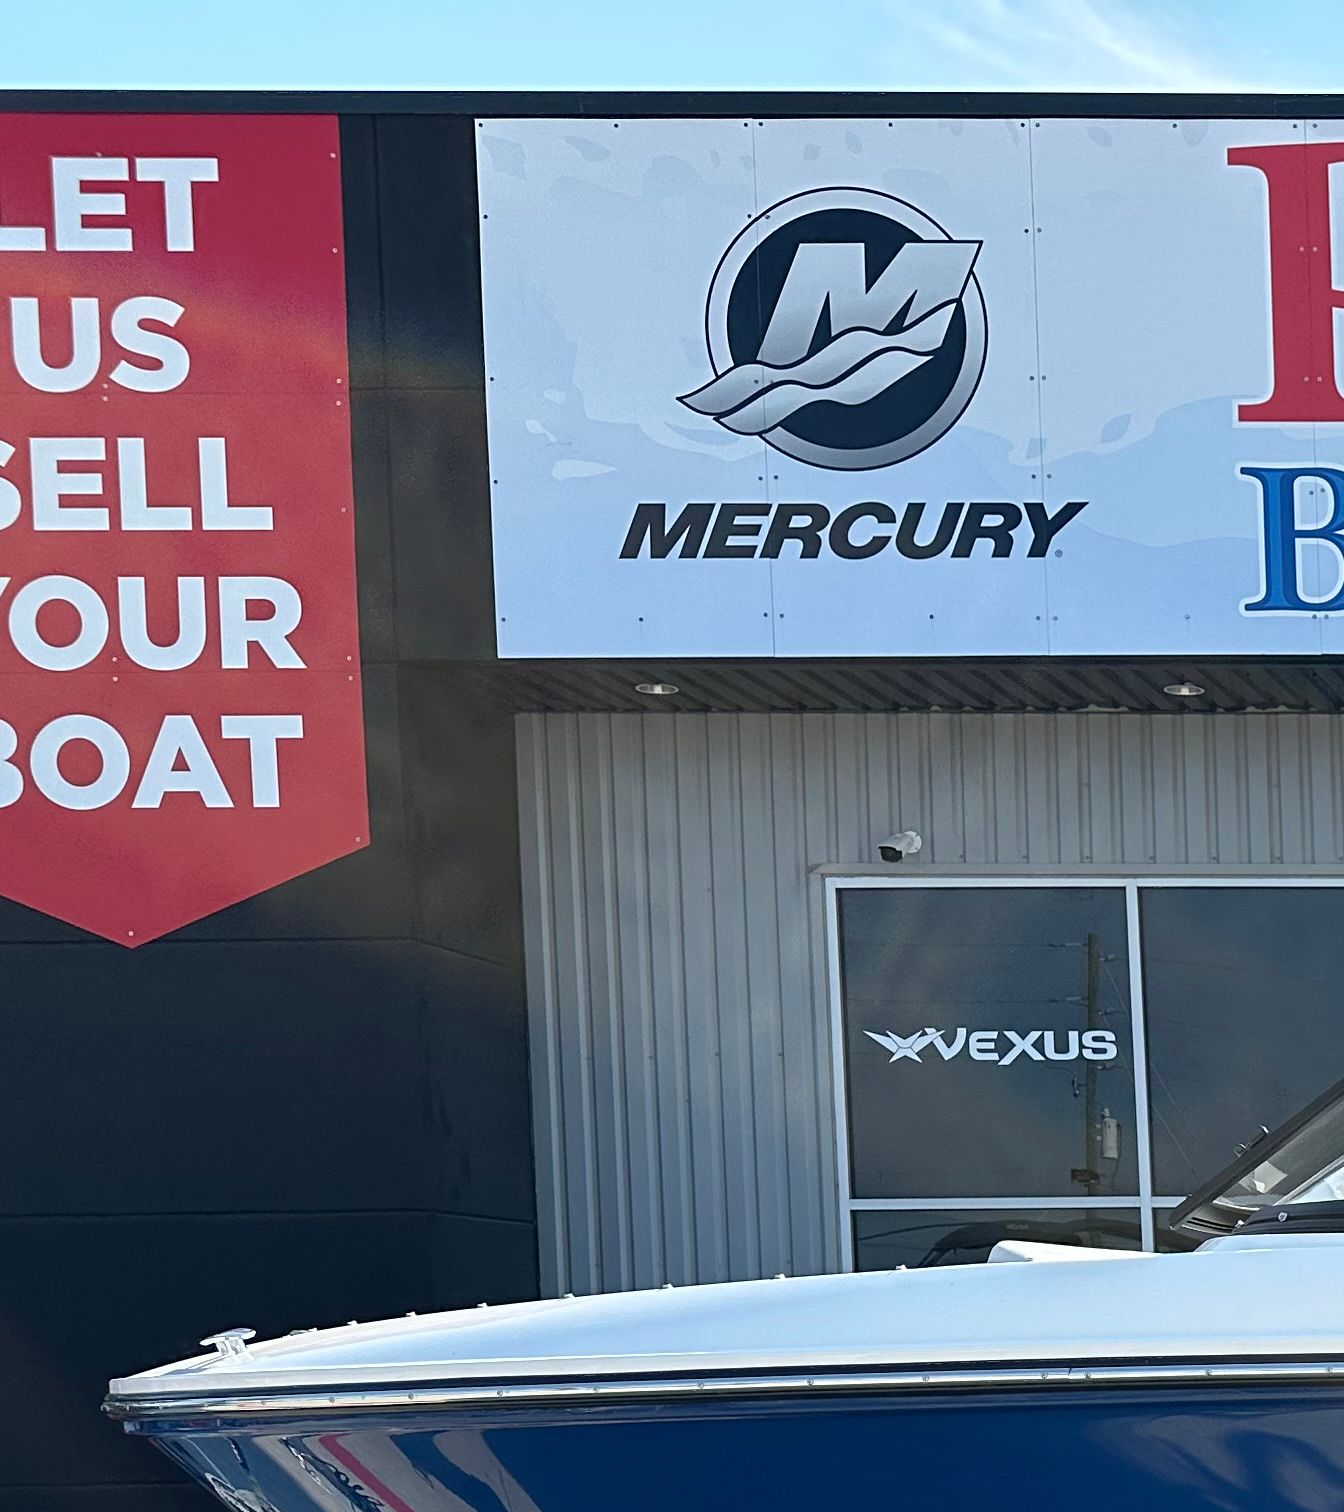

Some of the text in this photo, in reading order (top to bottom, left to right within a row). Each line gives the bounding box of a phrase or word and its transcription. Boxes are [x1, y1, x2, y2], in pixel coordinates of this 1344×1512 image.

[10, 296, 191, 393] US
[0, 436, 274, 532] ELL
[618, 501, 1089, 559] MERCURY
[0, 574, 308, 672] OUR
[924, 1027, 1118, 1065] VEXUS
